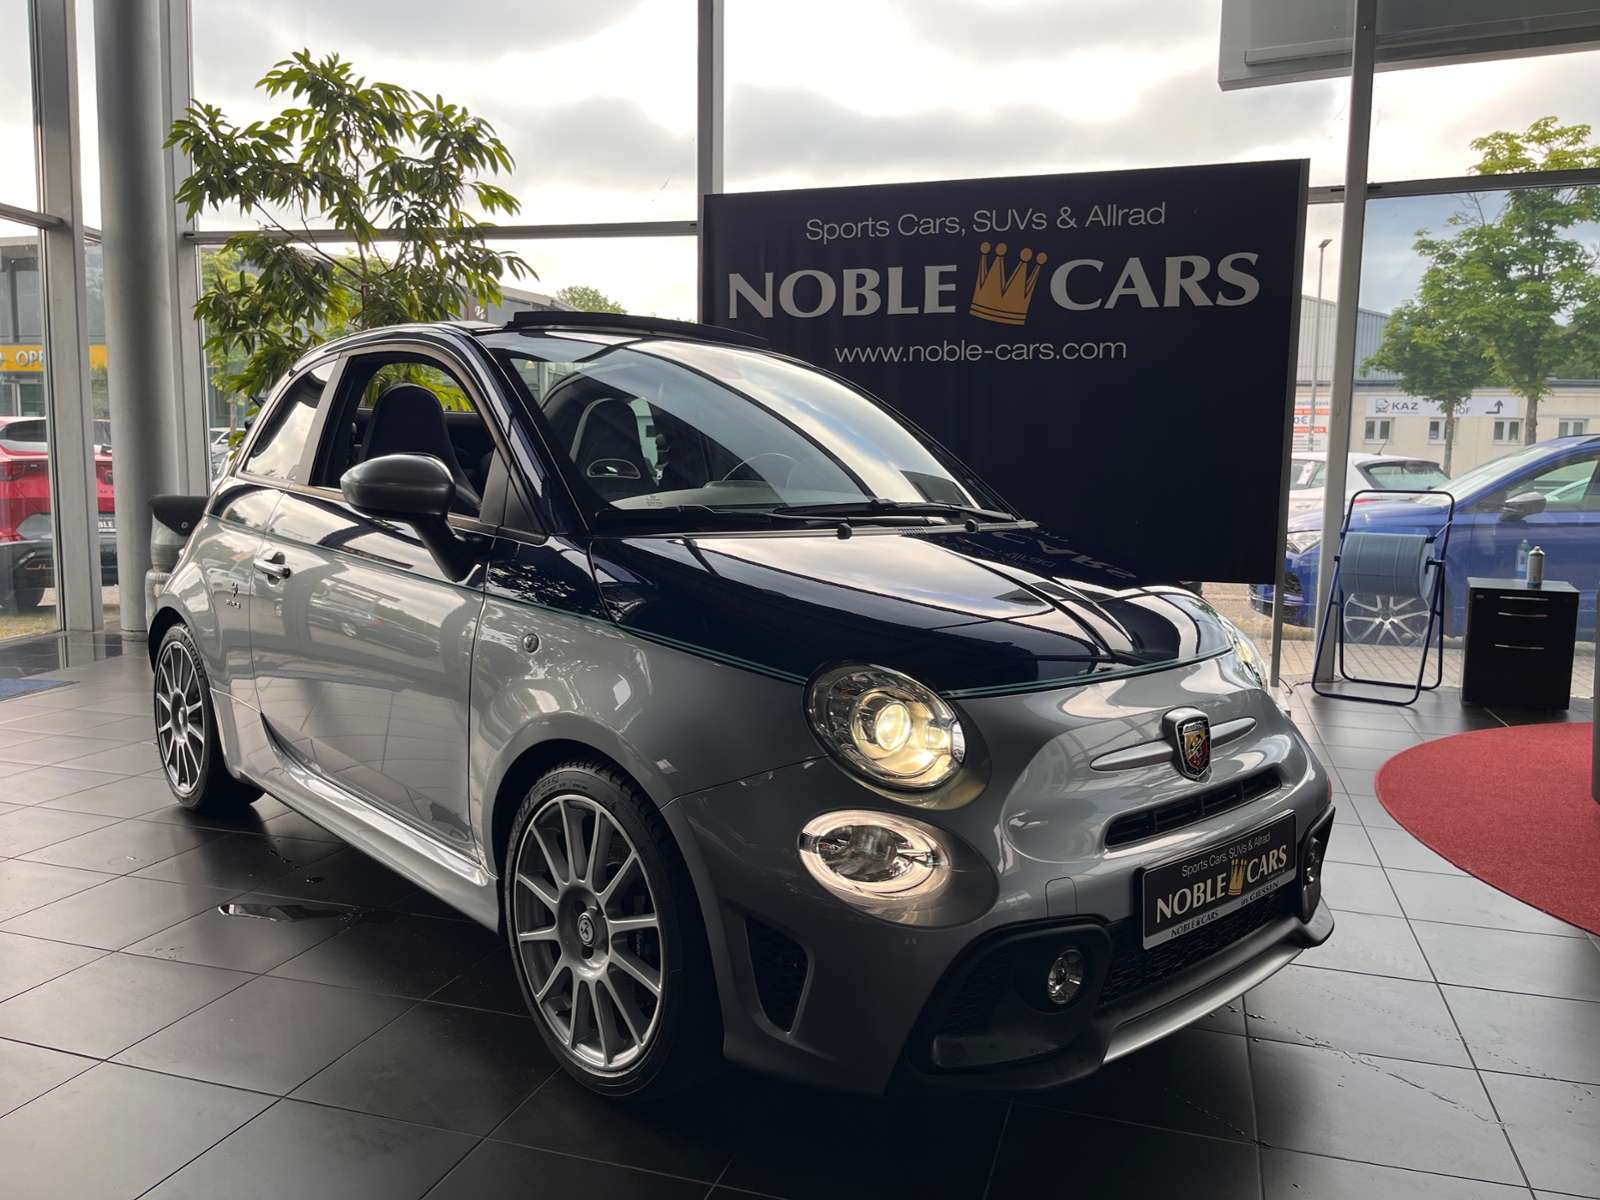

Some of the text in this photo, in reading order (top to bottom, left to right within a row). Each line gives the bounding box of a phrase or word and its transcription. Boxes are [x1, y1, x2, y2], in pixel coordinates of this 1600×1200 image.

[806, 201, 1166, 245] Sports Cars, SUVs & Allrad
[728, 252, 1260, 319] NOBLE CARS
[835, 339, 1127, 363] www.noble-cars.com
[1392, 402, 1418, 411] KAZ
[1181, 860, 1208, 878] Sports
[1228, 845, 1248, 859] SUVs
[1156, 845, 1287, 924] NOBLE CARS
